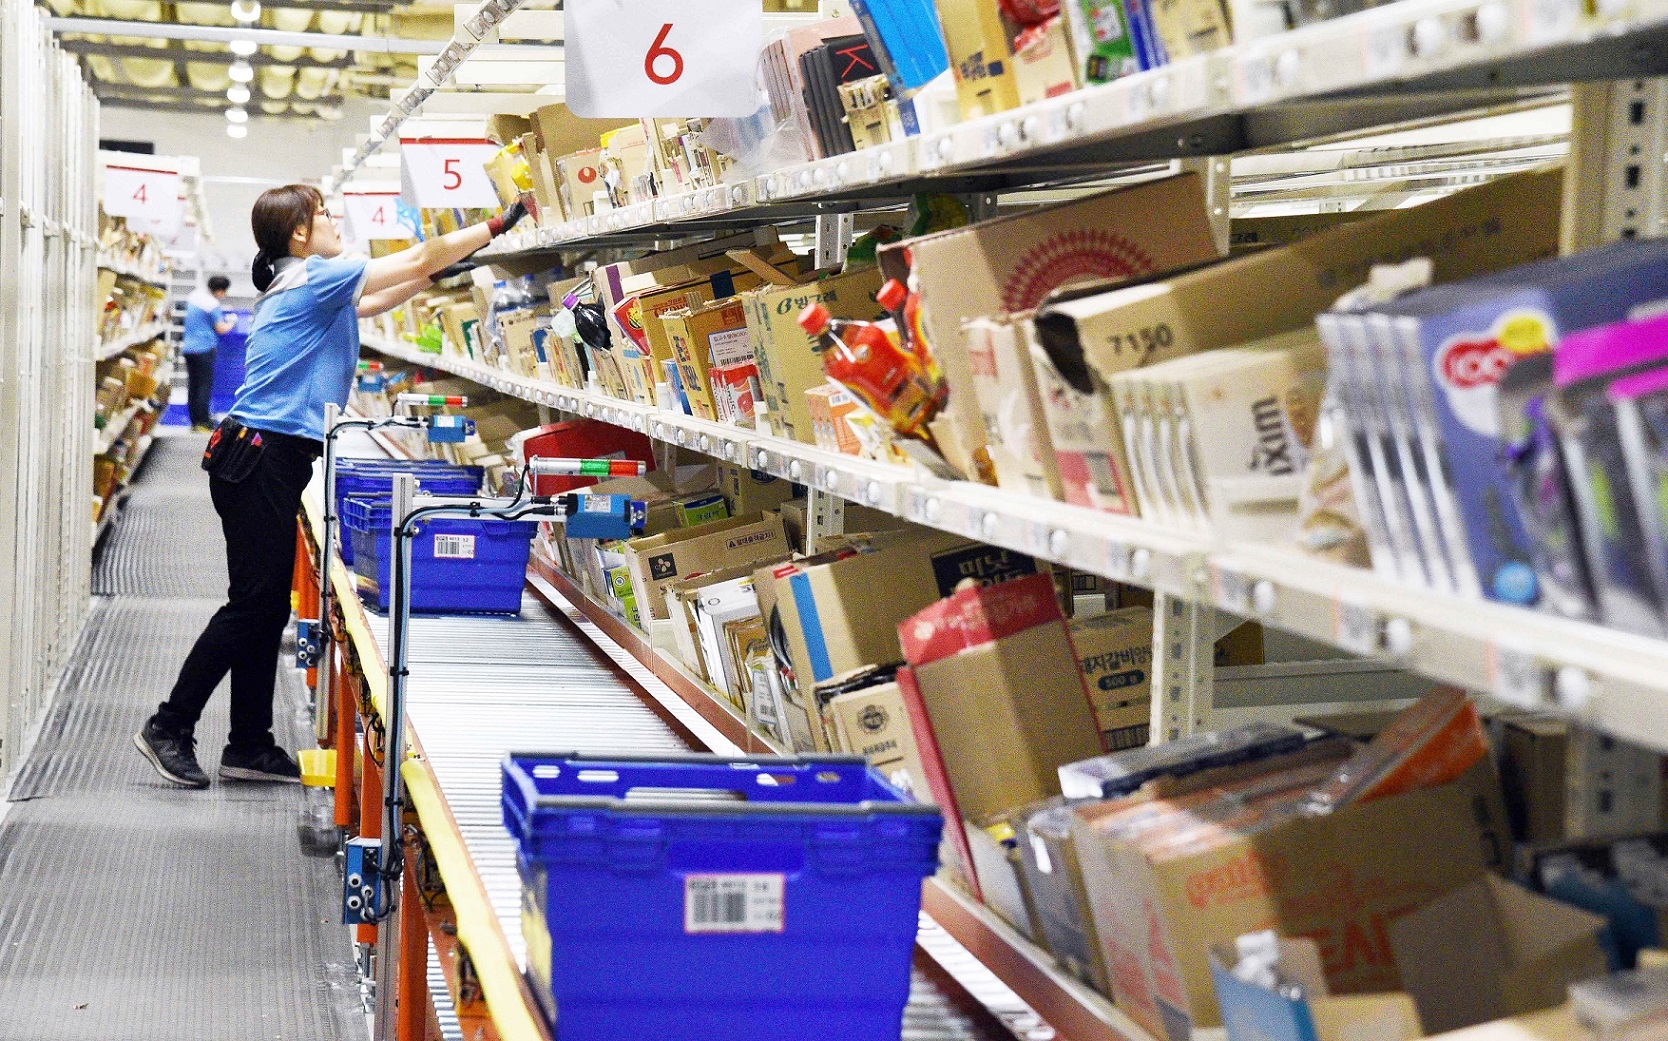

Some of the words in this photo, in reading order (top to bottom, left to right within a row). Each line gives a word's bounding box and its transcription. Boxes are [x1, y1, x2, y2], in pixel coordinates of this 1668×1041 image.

[644, 23, 684, 85] 6
[835, 44, 875, 84] K
[443, 159, 462, 190] 5
[133, 184, 147, 204] 4
[372, 206, 385, 225] 4
